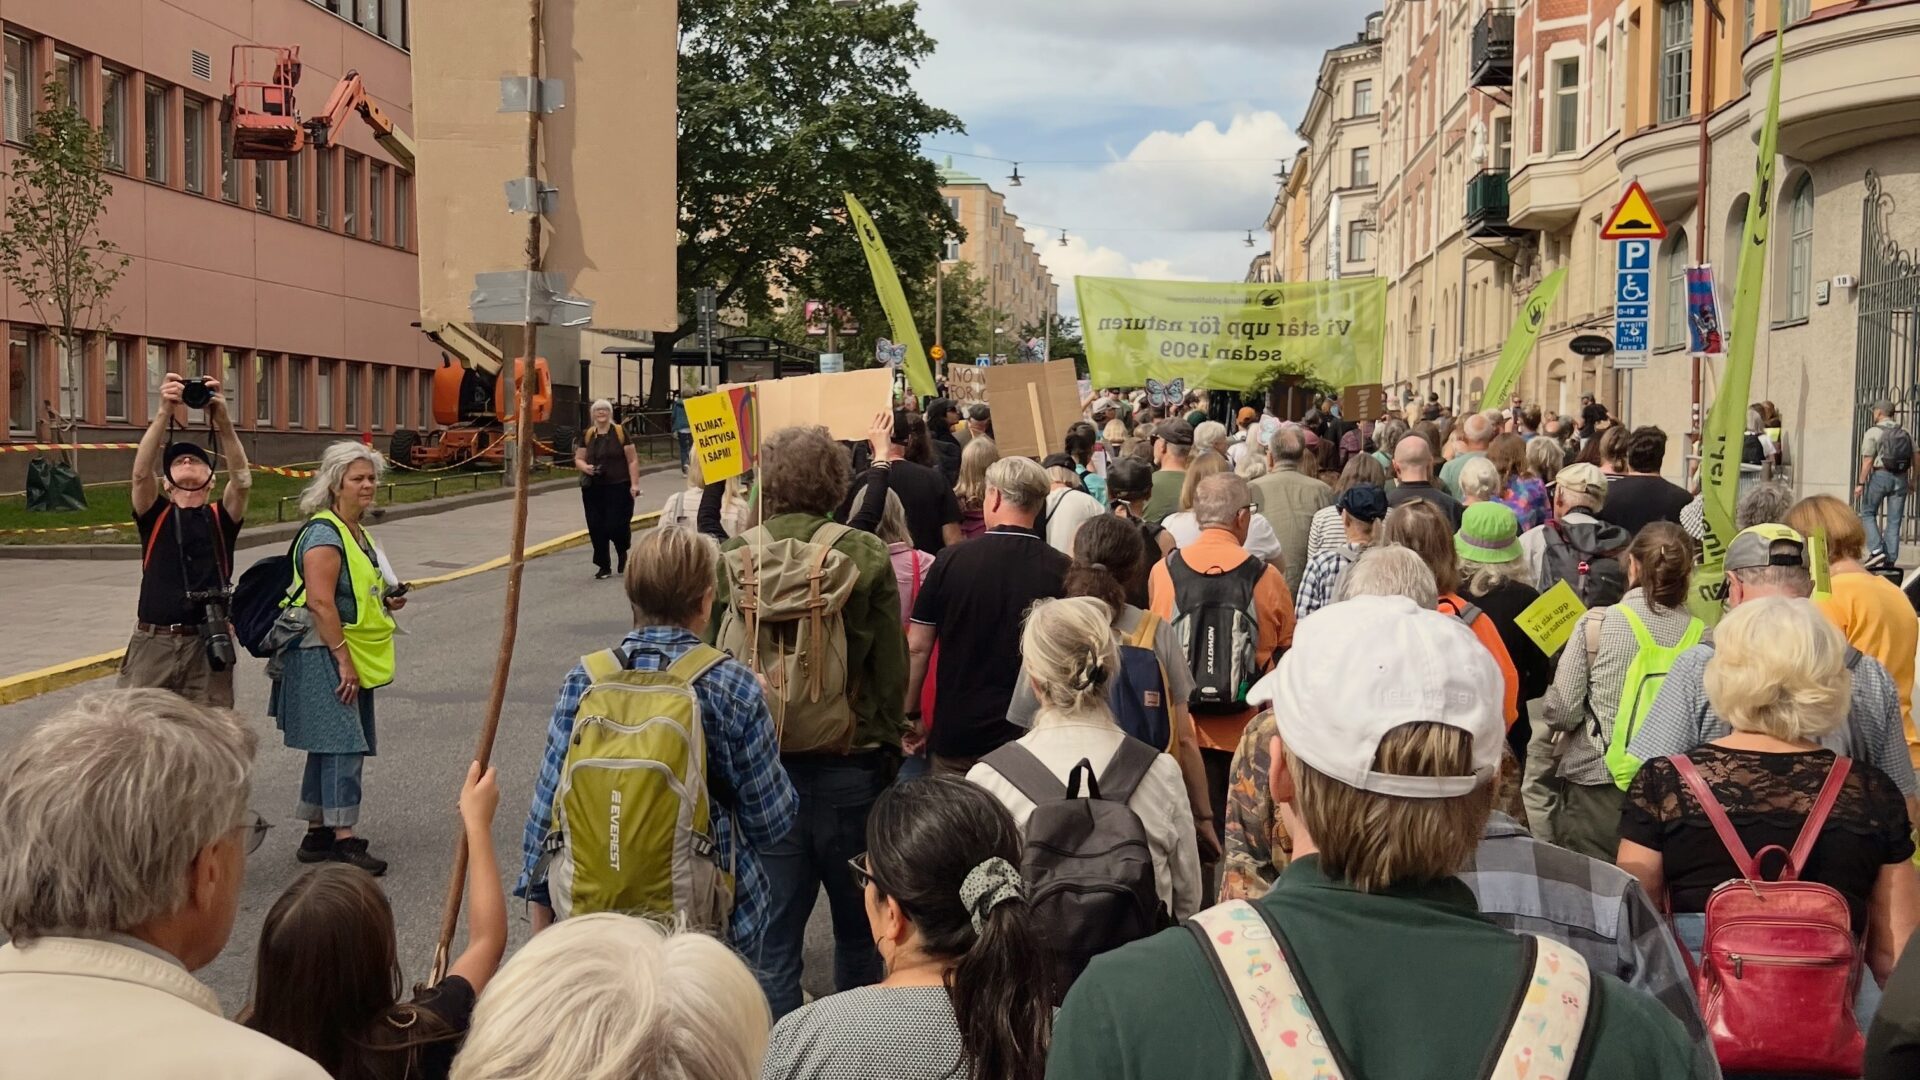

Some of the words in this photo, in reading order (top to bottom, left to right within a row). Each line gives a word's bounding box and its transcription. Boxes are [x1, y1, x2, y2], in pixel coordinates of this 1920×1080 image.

[1625, 242, 1646, 268] P
[1837, 277, 1847, 285] 18
[1619, 322, 1645, 330] Avgift
[953, 367, 973, 383] NO
[950, 384, 975, 401] FOR
[694, 417, 726, 433] KLIMAT-
[1532, 624, 1542, 633] Vi
[1553, 602, 1569, 615] upp
[1207, 626, 1215, 675] SALOMON
[610, 804, 620, 871] EVEREST
